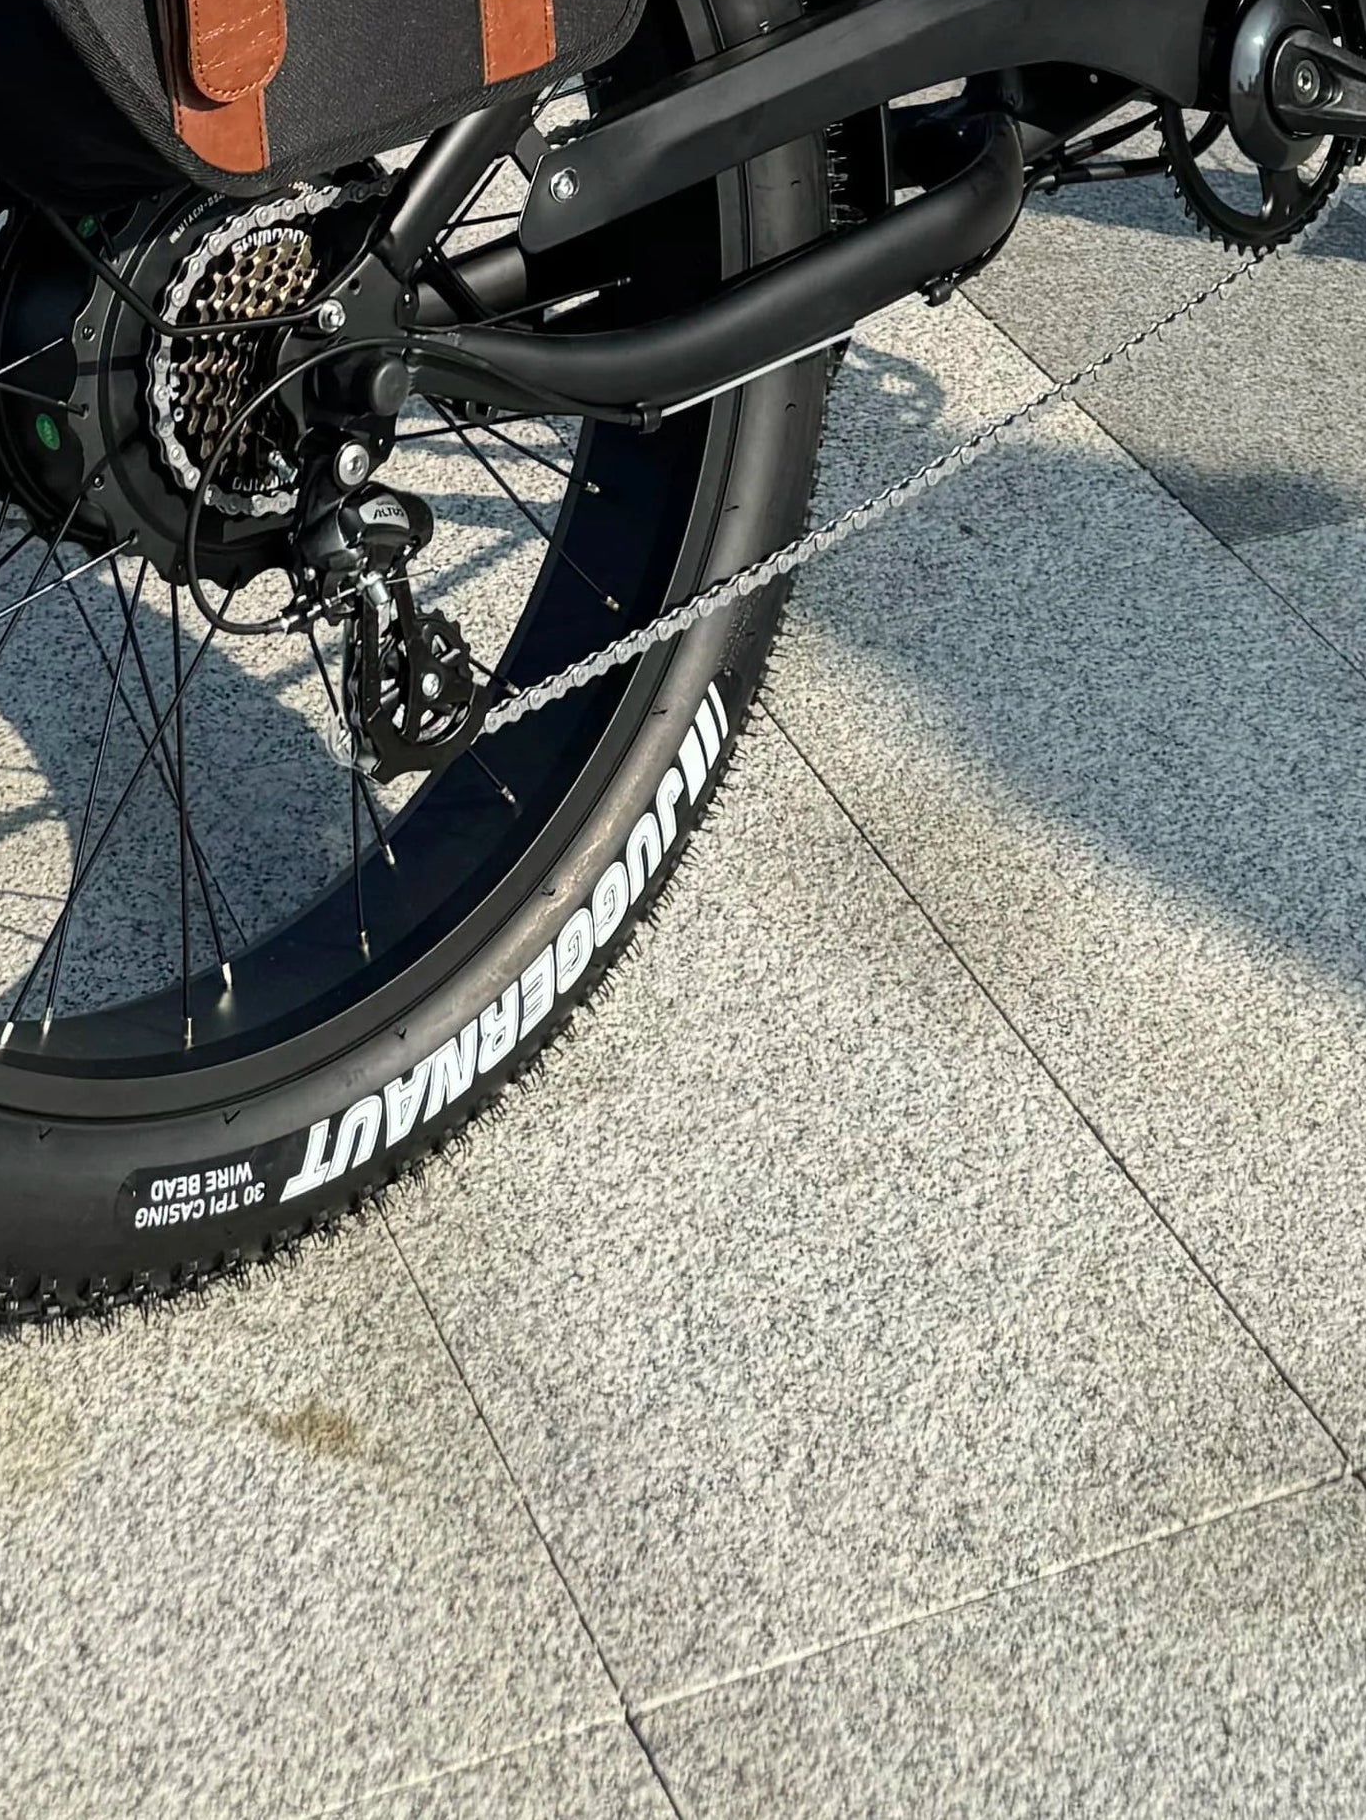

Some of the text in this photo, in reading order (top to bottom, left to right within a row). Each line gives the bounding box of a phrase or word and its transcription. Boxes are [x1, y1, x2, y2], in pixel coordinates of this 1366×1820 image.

[280, 766, 685, 1204] JUGGERNAUT
[150, 1161, 254, 1202] WIRE BEAD
[134, 1182, 266, 1229] 30 TPI CASING
